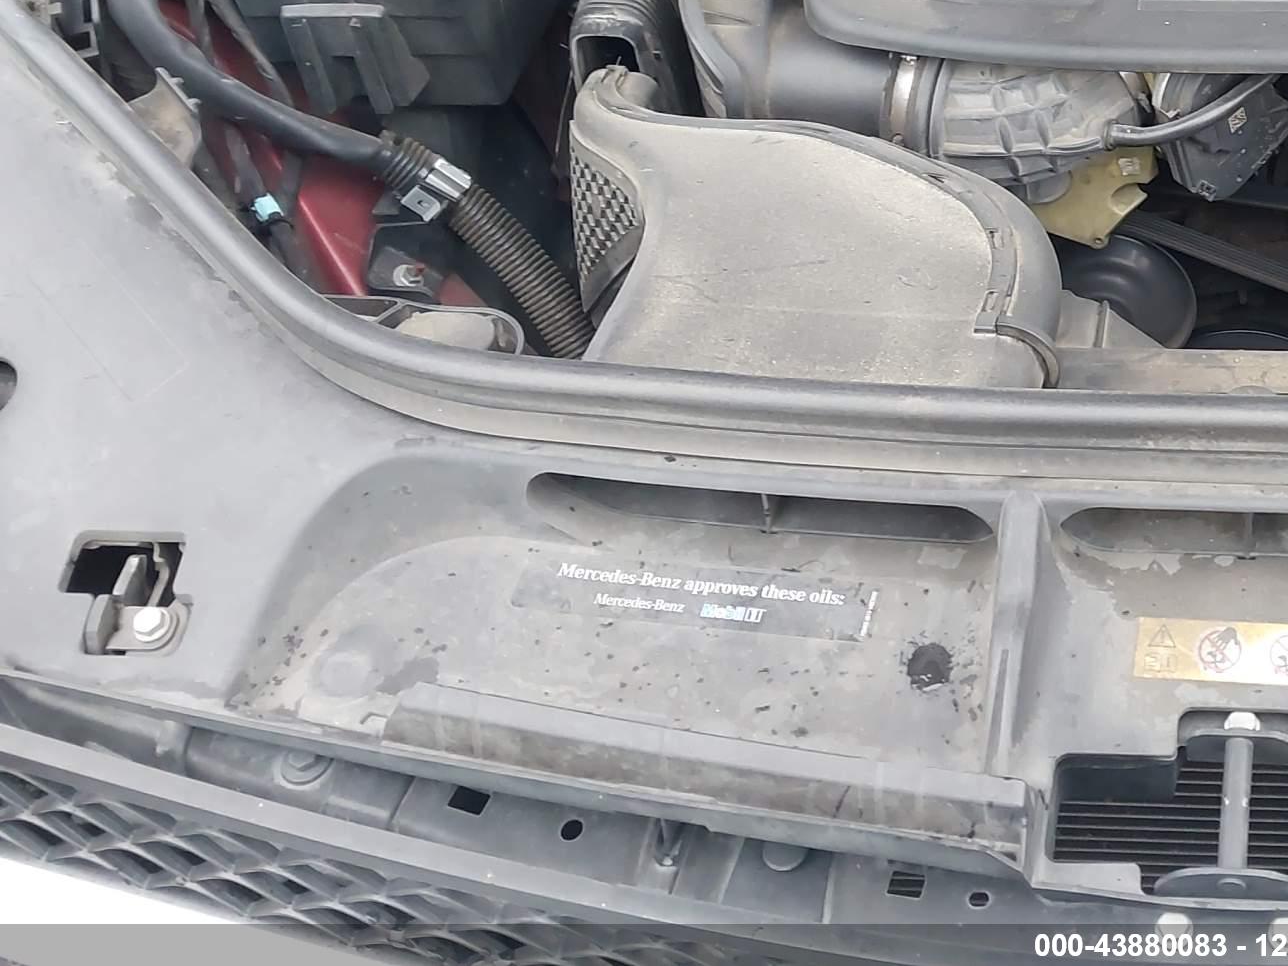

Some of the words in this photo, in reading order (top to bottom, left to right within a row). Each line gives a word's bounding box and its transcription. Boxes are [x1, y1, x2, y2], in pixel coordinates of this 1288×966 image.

[557, 562, 681, 590] Mercedes-Benz
[683, 579, 759, 597] approves
[760, 583, 807, 602] these
[808, 589, 846, 605] oils:
[593, 592, 686, 613] Mercedes-Benz
